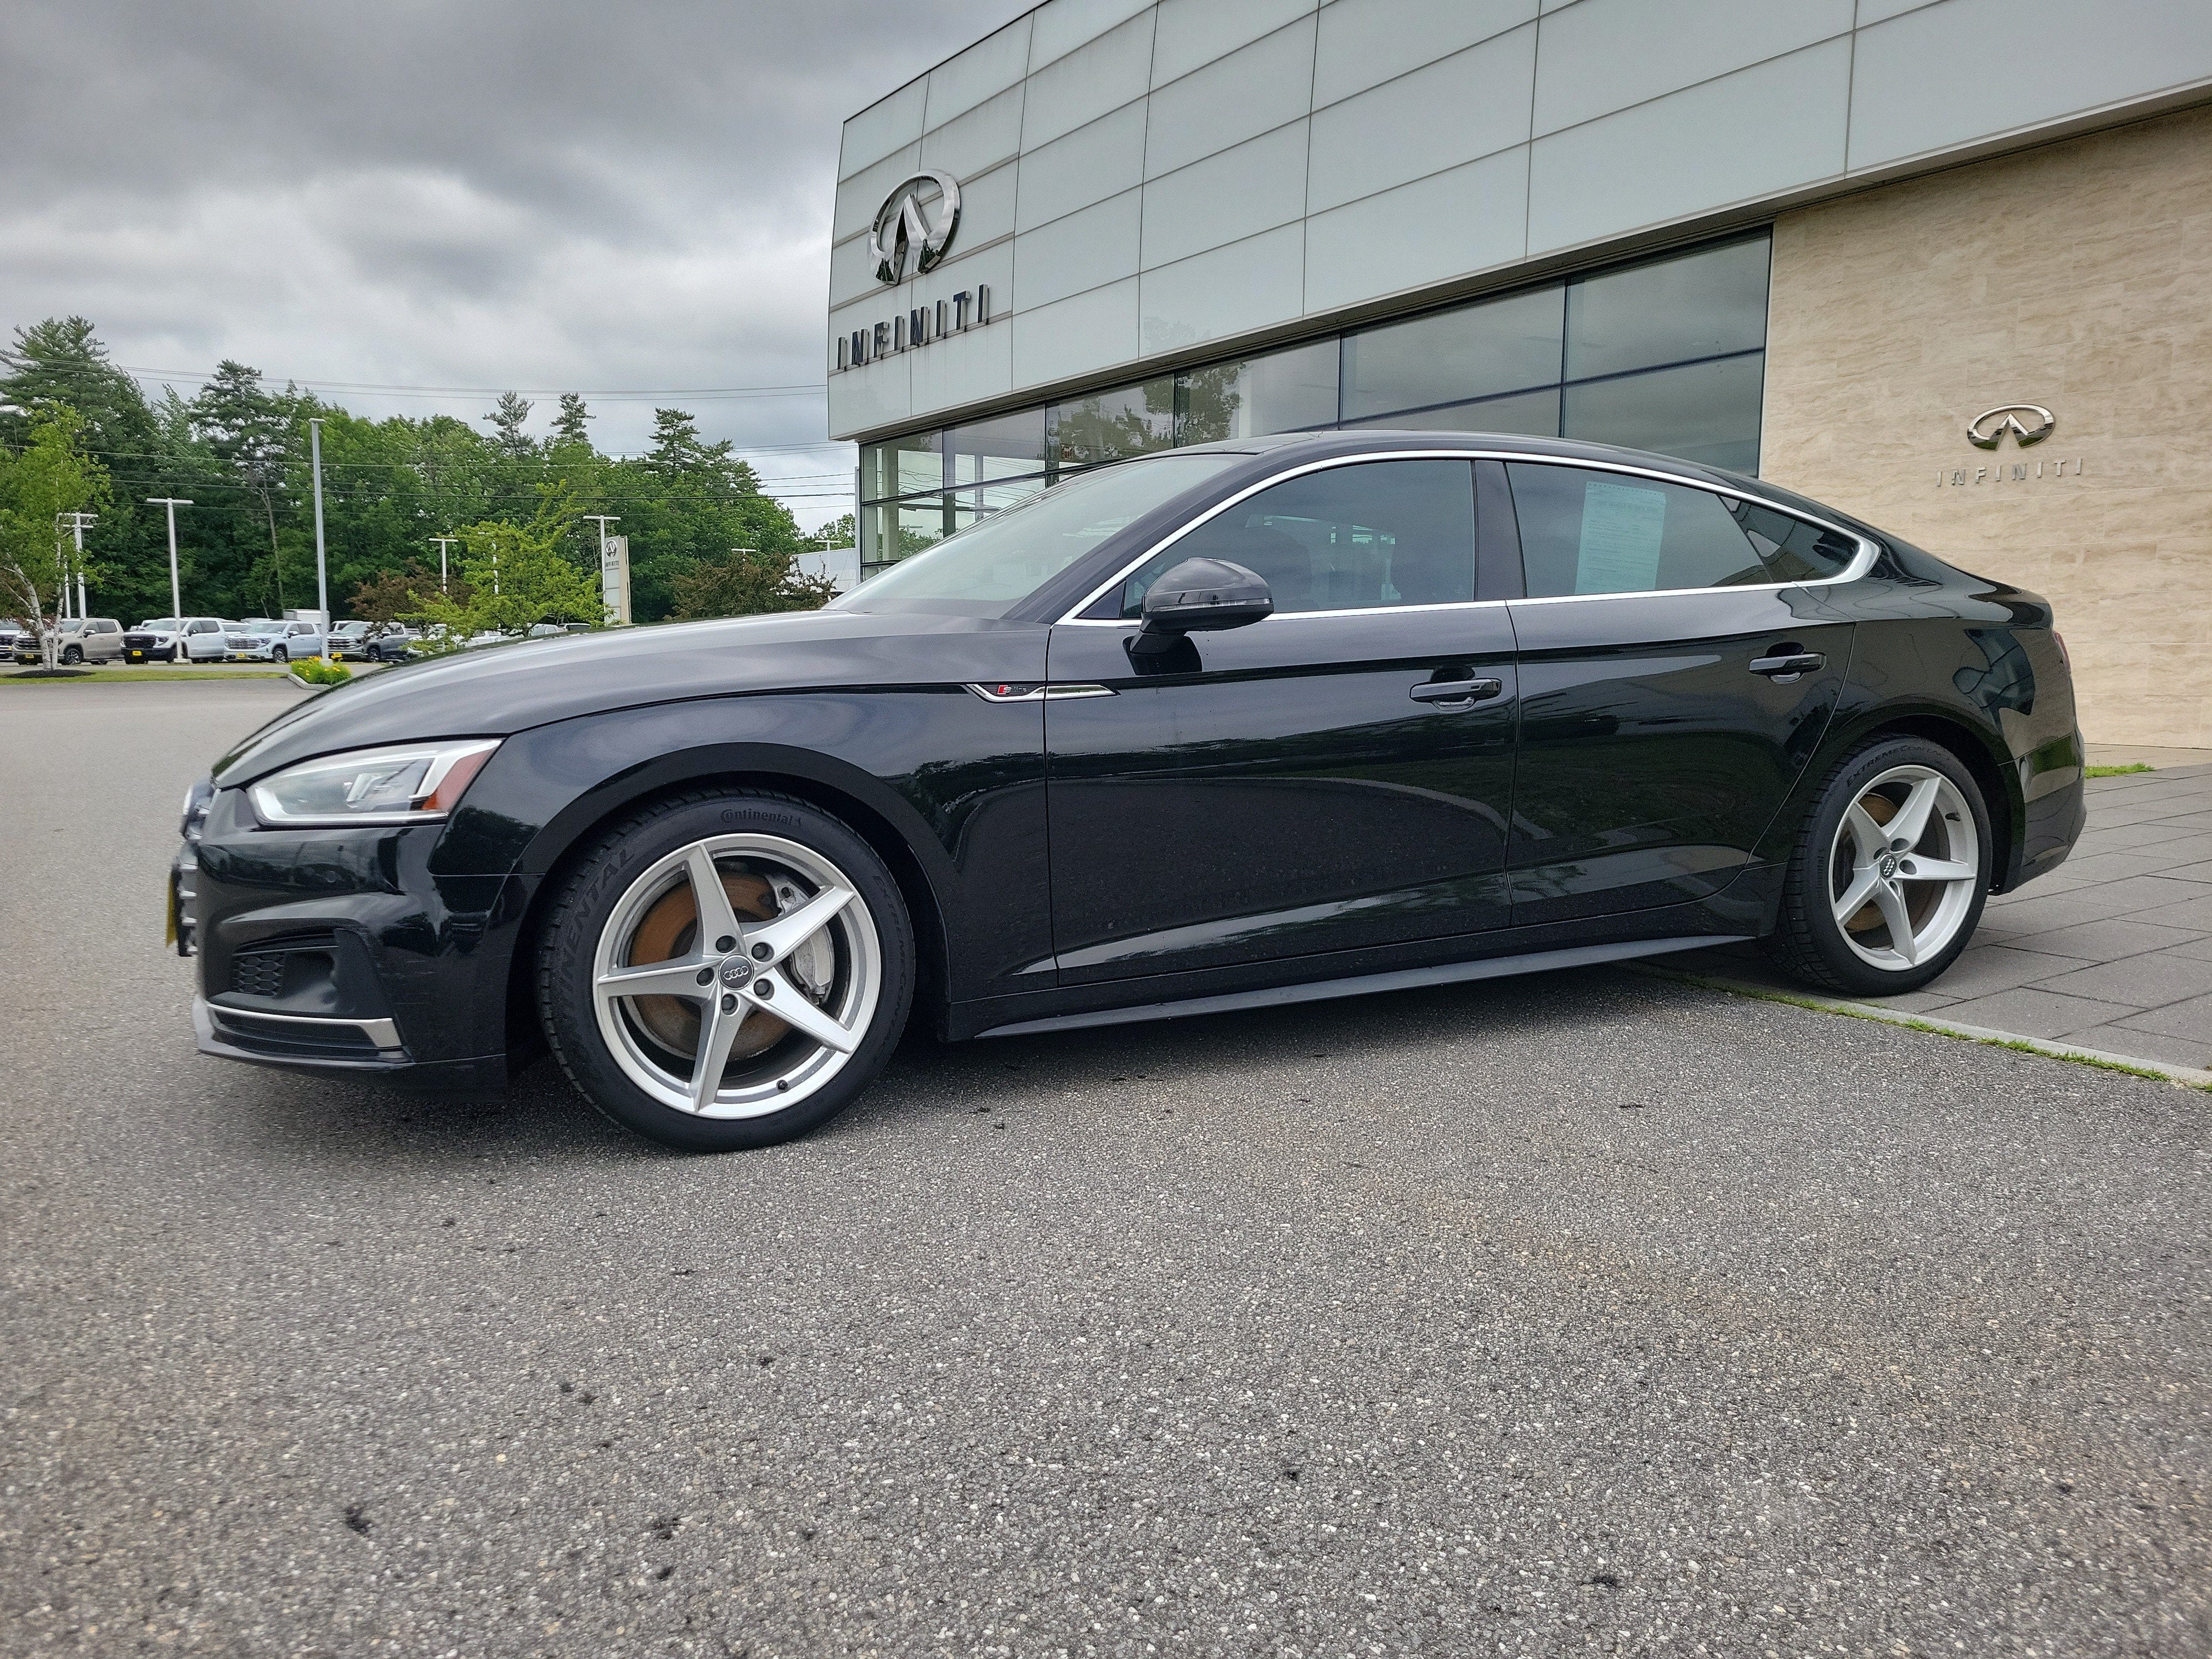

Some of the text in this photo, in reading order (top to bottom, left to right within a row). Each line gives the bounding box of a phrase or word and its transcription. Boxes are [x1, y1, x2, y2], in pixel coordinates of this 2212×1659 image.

[837, 284, 989, 370] INFINITI
[1936, 457, 2083, 487] INFINITI
[720, 808, 793, 825] Continental
